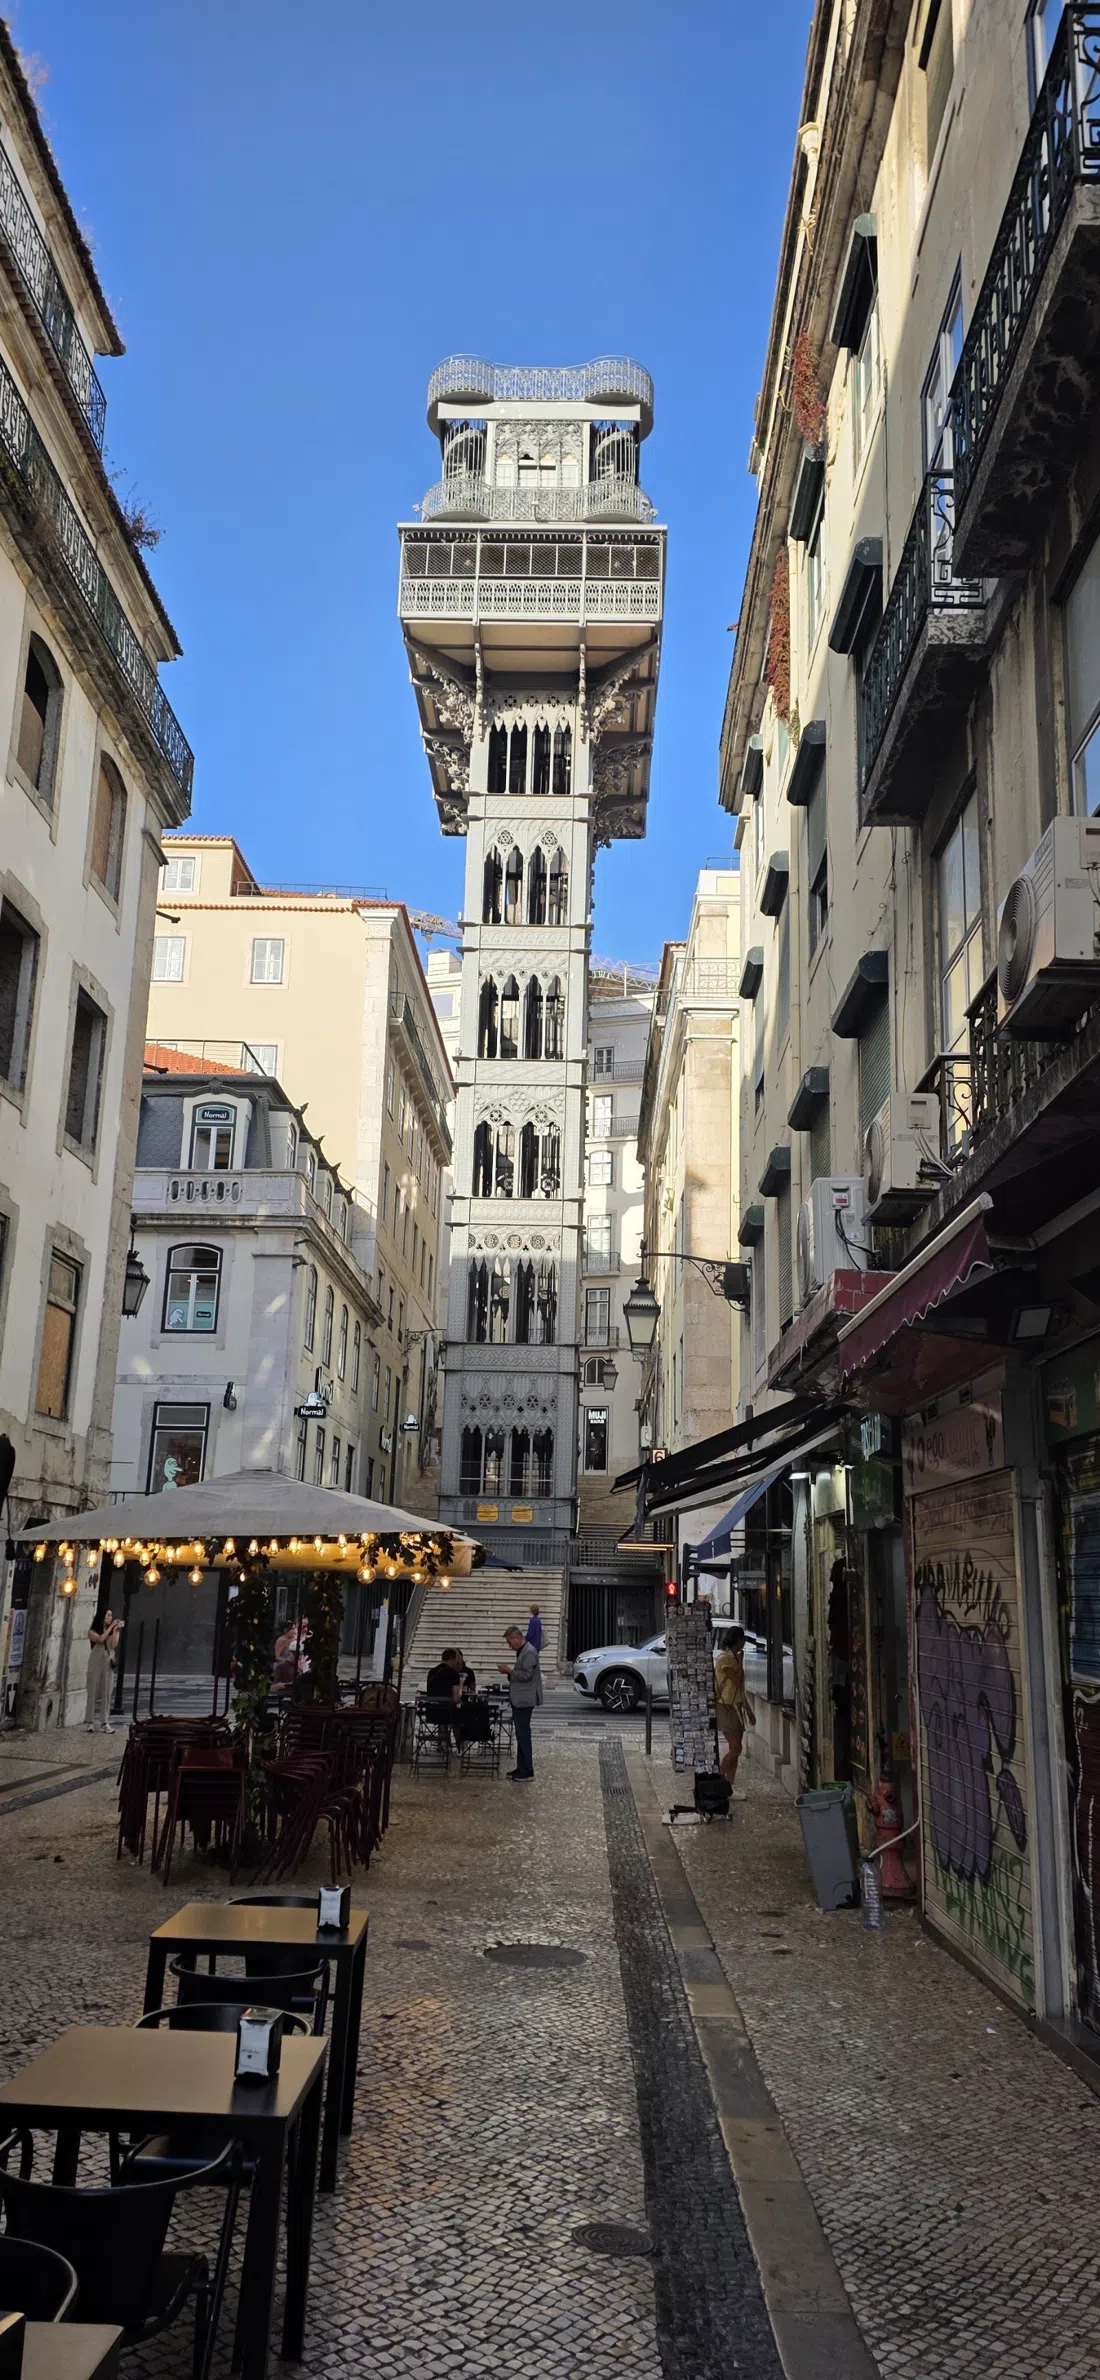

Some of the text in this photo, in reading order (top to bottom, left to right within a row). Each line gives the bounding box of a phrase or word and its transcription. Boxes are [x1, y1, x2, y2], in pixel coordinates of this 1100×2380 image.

[204, 1111, 227, 1119] Normal
[300, 1407, 324, 1416] Normal
[588, 1410, 607, 1420] MUJI
